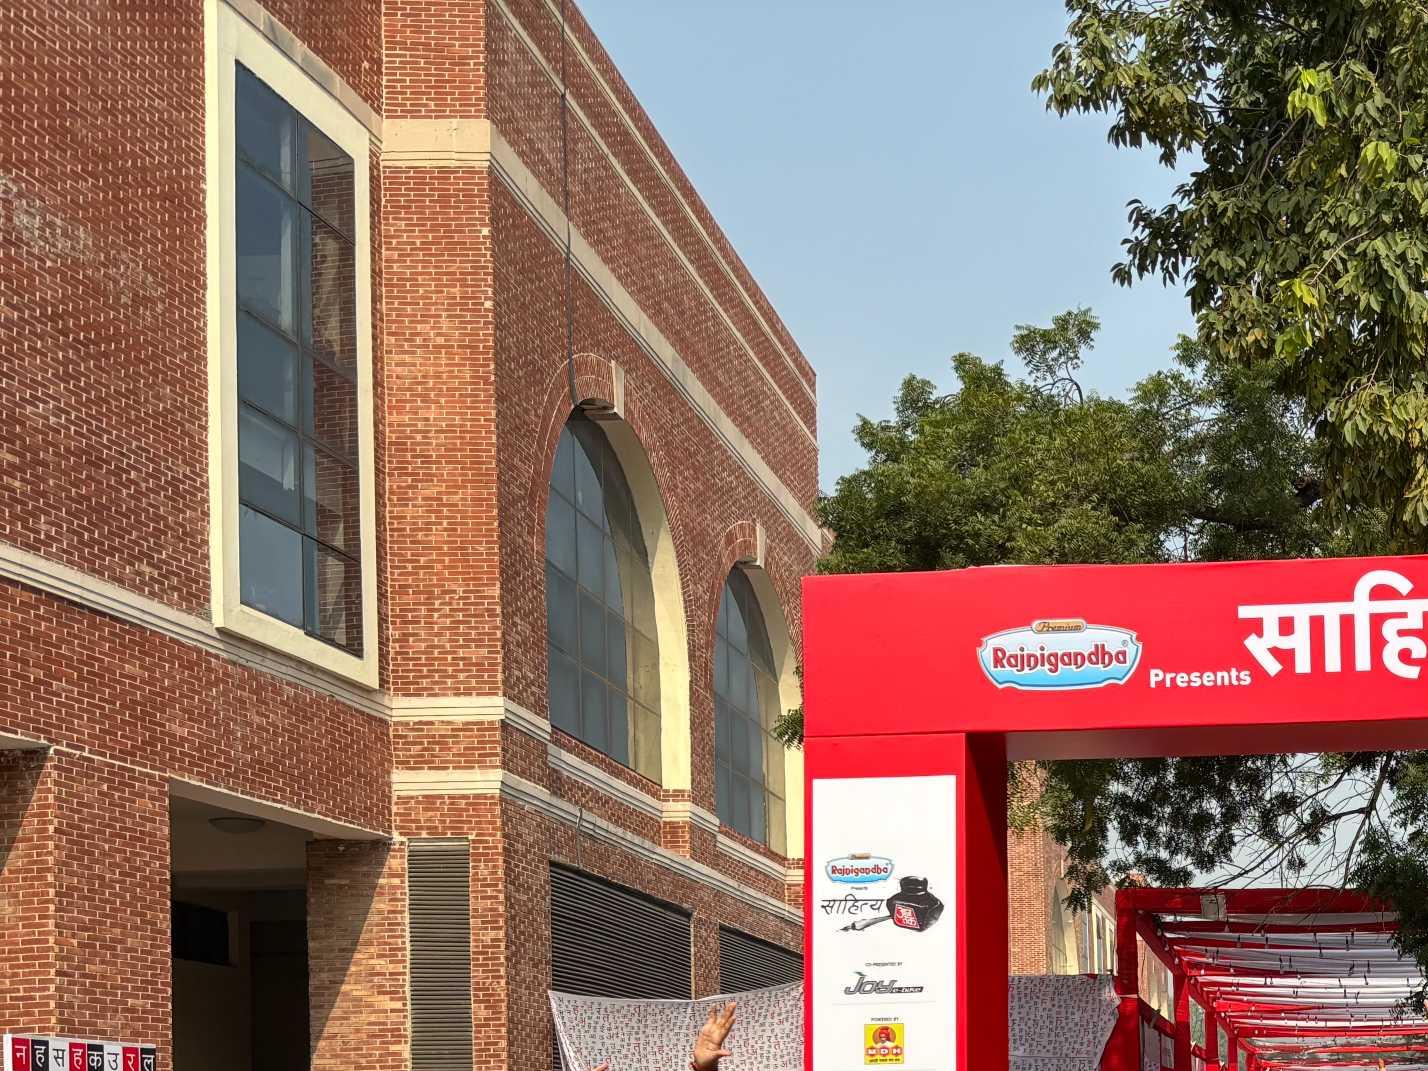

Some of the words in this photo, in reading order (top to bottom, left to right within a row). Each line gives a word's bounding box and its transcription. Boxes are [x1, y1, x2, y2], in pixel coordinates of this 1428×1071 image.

[1036, 621, 1082, 632] Premium
[992, 643, 1128, 673] Rajnigandha
[1150, 667, 1251, 688] Presents
[831, 864, 889, 877] Rajnigandha
[821, 894, 885, 915] साहित्य
